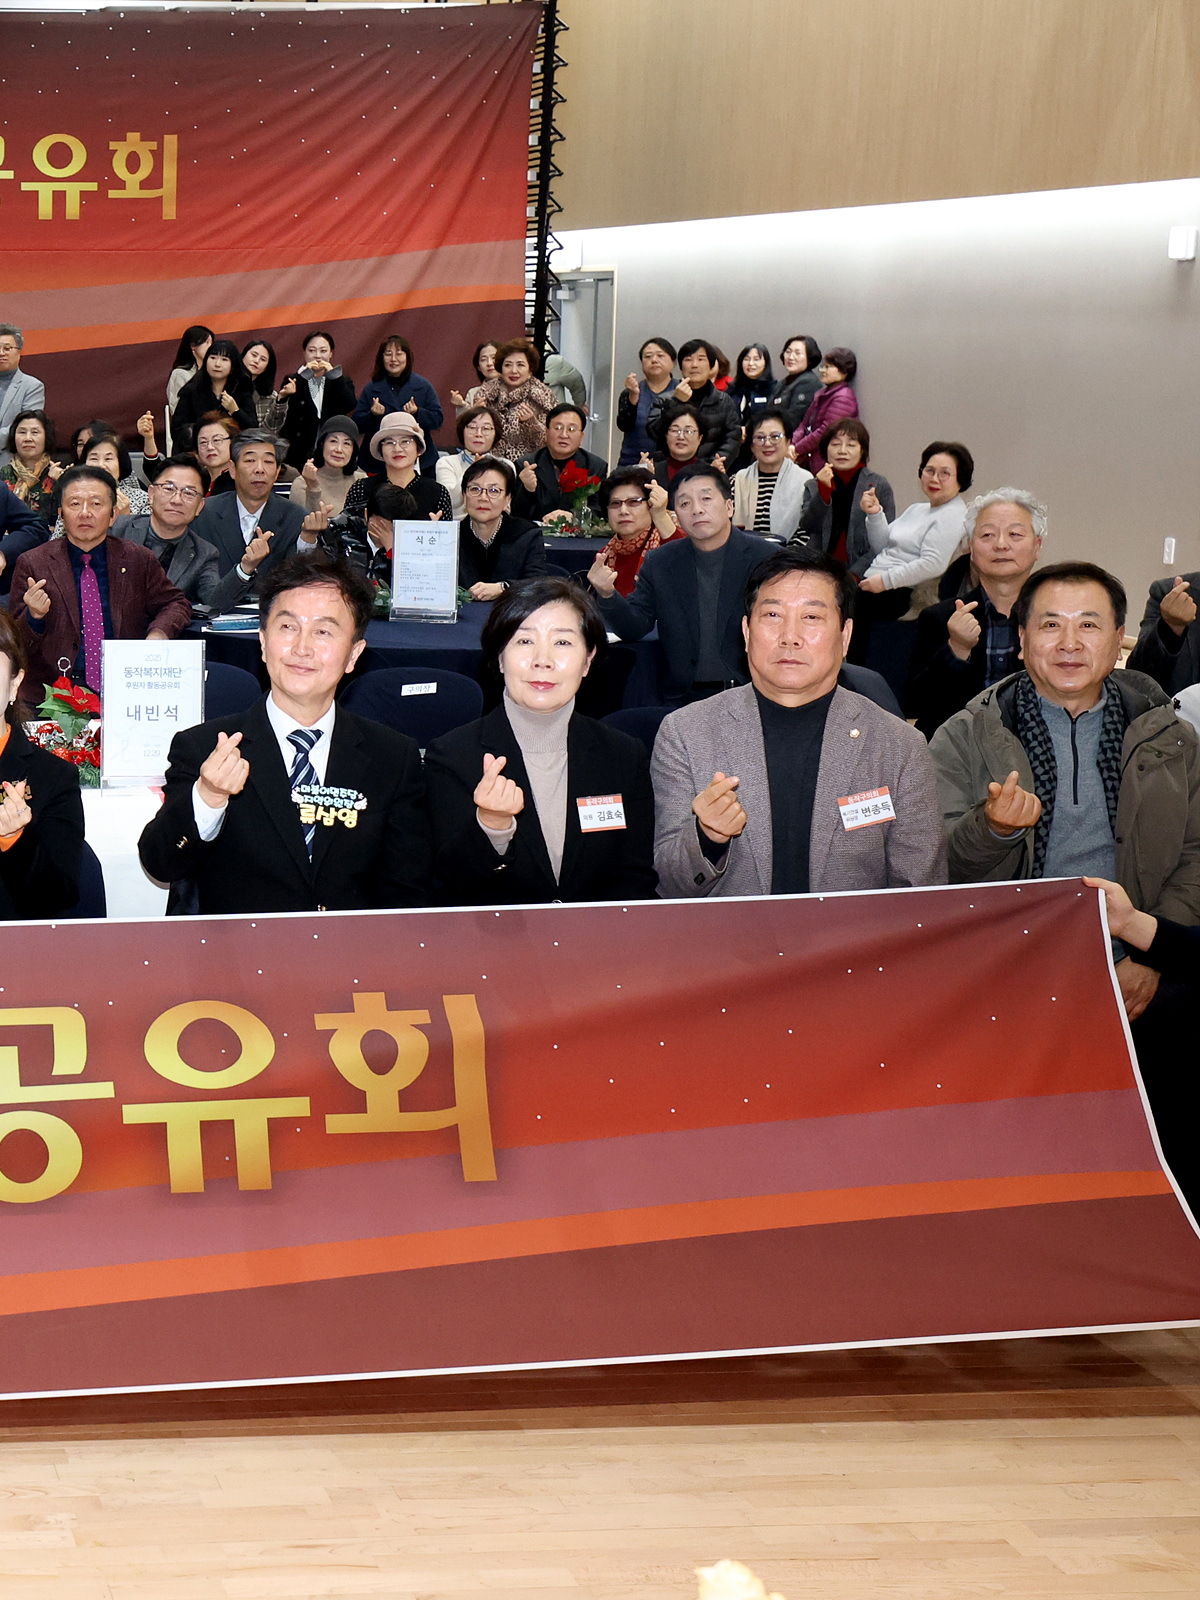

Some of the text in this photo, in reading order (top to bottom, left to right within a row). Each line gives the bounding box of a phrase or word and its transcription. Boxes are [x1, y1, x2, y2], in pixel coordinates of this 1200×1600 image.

[123, 667, 183, 679] 동작복지재단
[125, 681, 181, 690] 후원자 활동공유회
[847, 790, 880, 804] 동작구의회
[299, 803, 359, 829] 류삼영
[597, 810, 623, 822] 김효숙
